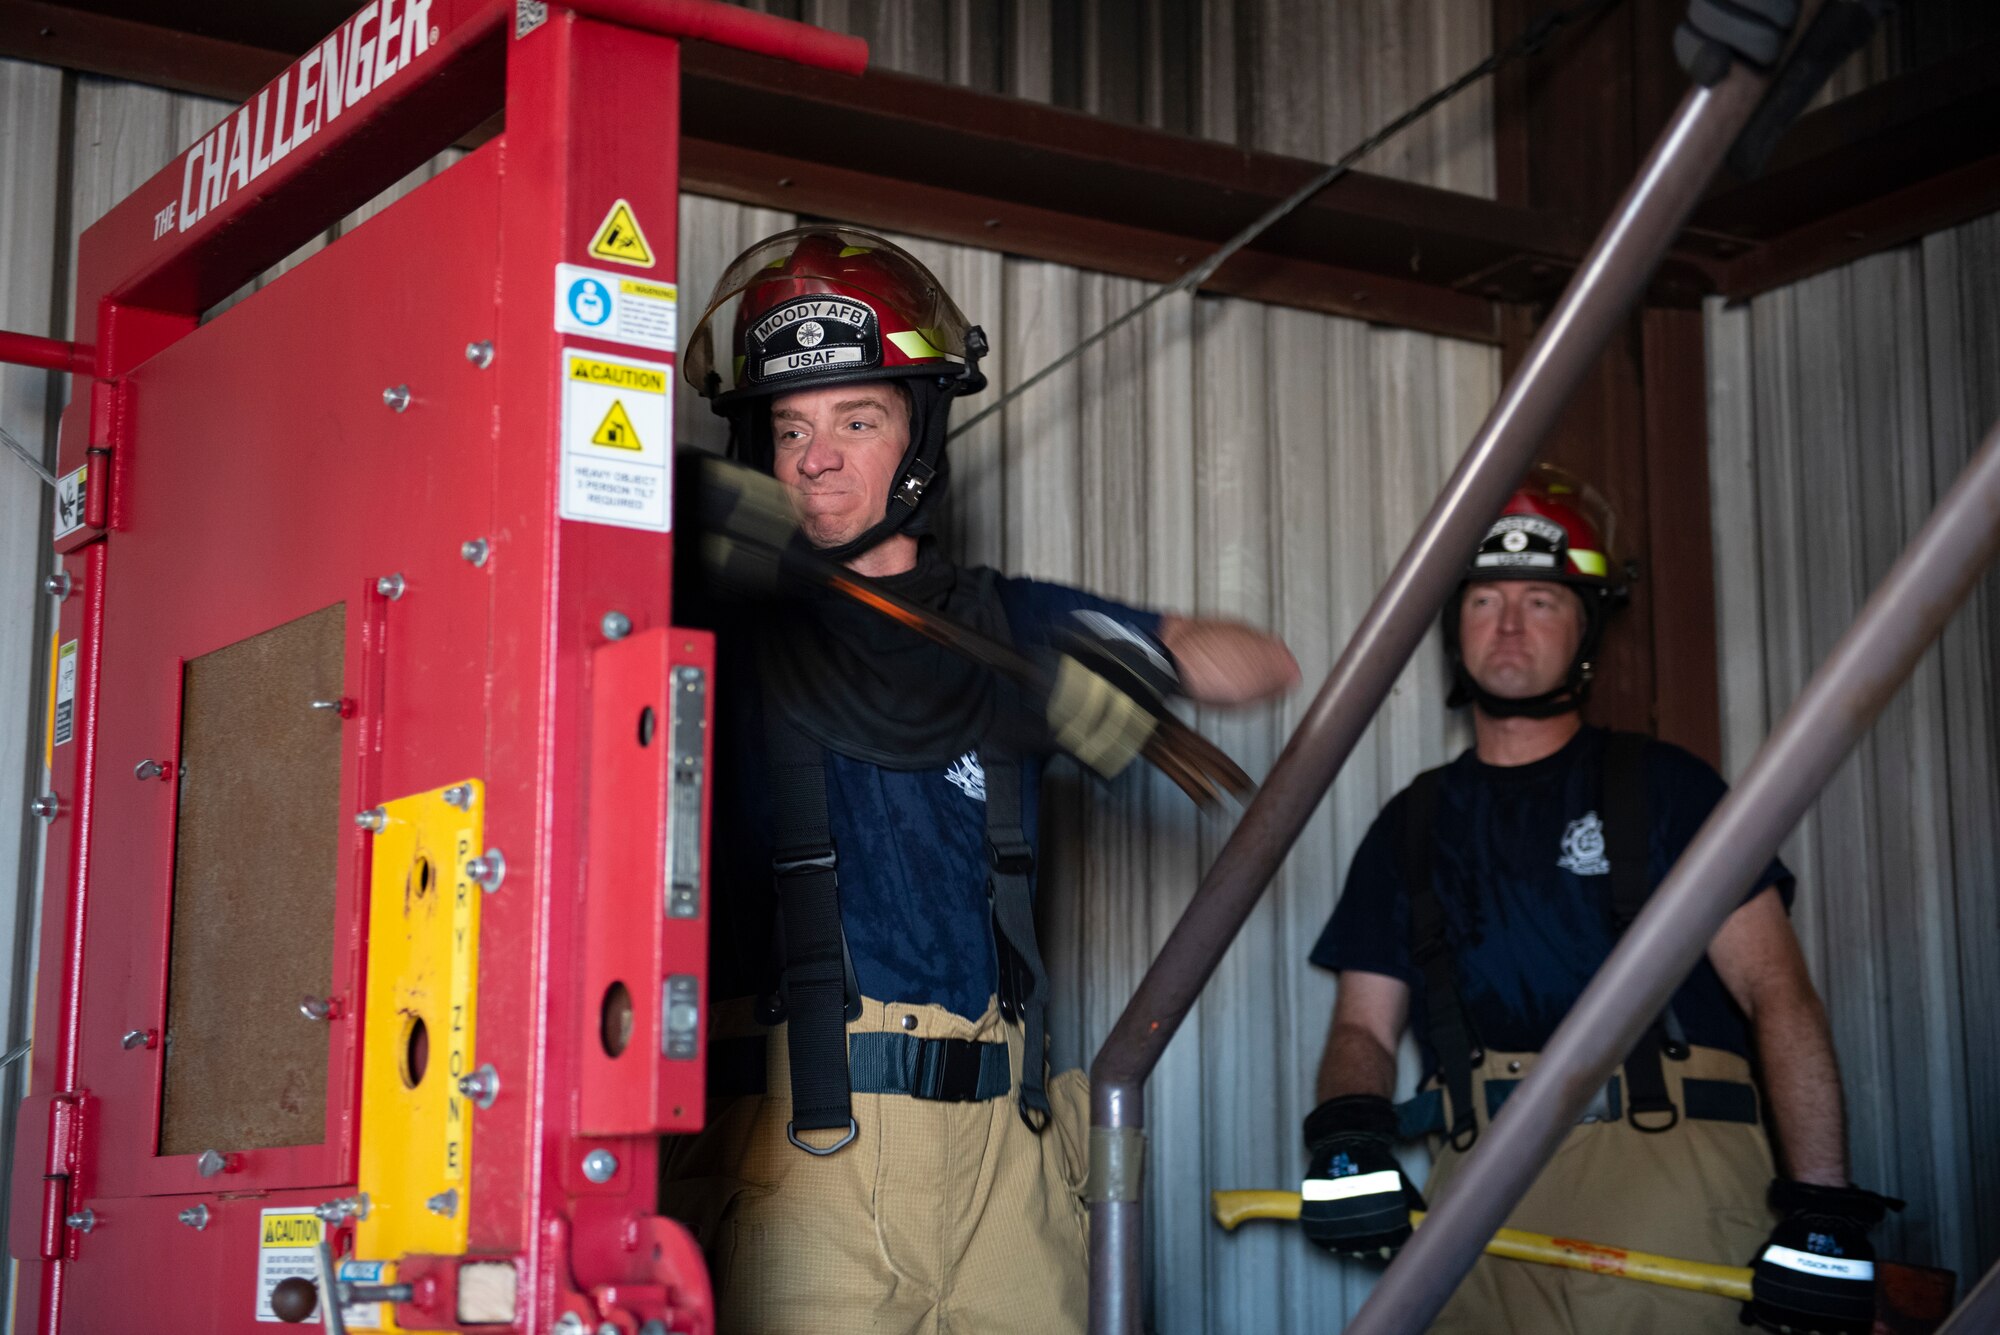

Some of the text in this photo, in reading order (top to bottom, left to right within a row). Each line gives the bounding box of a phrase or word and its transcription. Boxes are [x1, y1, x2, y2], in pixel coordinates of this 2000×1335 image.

[153, 200, 177, 240] THE
[757, 303, 863, 339] MOODY AFB
[788, 350, 836, 369] USAF
[590, 364, 662, 389] CAUTION
[585, 480, 631, 495] PERSON
[613, 472, 657, 486] OBJECT
[587, 494, 644, 510] REQUIRED
[448, 839, 468, 1168] PRY ZONE
[275, 1219, 320, 1242] CAUTION
[1797, 1257, 1850, 1274] FUSION PRO
